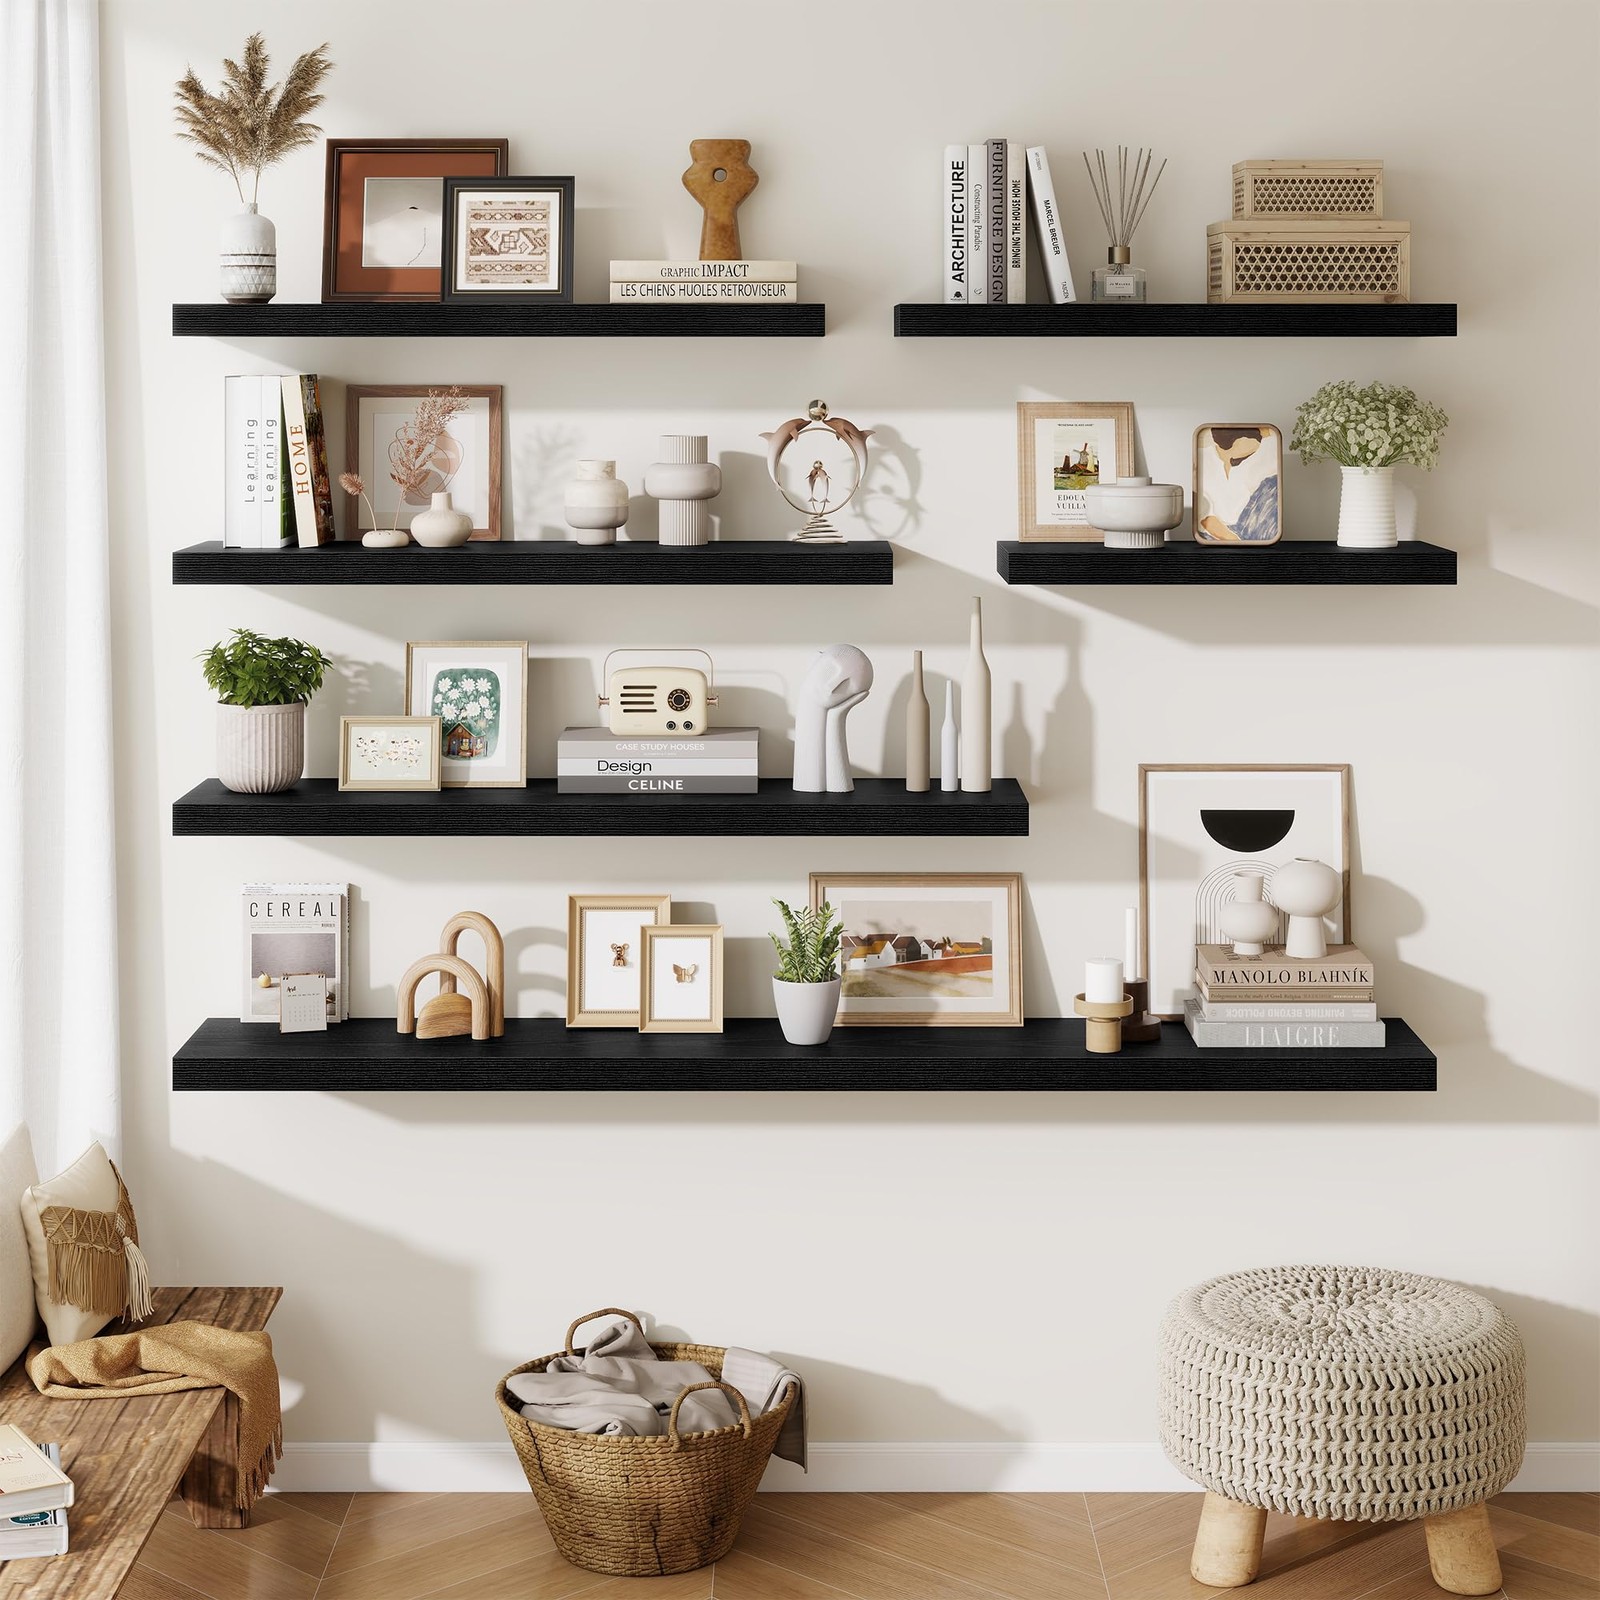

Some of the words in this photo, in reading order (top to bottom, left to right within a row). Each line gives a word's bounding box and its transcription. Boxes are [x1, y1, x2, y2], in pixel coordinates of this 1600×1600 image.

[992, 142, 1004, 237] FURNITURE
[1011, 179, 1021, 198] HOME
[1011, 199, 1021, 221] HOUSE
[952, 160, 965, 283] ARCHITECTURE
[1011, 222, 1021, 236] THE
[1043, 199, 1055, 228] MARCEL
[1049, 227, 1061, 256] BREUER
[1011, 236, 1021, 269] BRINGING
[660, 267, 700, 278] GRAPHIC
[701, 264, 750, 278] IMPACT
[992, 242, 1004, 302] DESIGN
[620, 283, 637, 297] LES
[639, 283, 676, 297] CHIENS
[678, 283, 718, 297] HUOLES
[721, 283, 787, 297] RETROVISEUR
[244, 419, 259, 503] Learning
[263, 419, 278, 503] Learning
[289, 424, 310, 495] HOME
[1056, 502, 1087, 510] VUILLA
[1057, 494, 1086, 502] EDOUA
[615, 743, 639, 751] CASE
[640, 743, 668, 751] STUDY
[670, 743, 705, 751] HOUSES
[597, 760, 652, 775] Design
[628, 779, 684, 791] CELINE
[249, 901, 337, 918] CEREAL
[1213, 969, 1291, 984] MANOLO
[1298, 967, 1369, 984] BLAHNÍK
